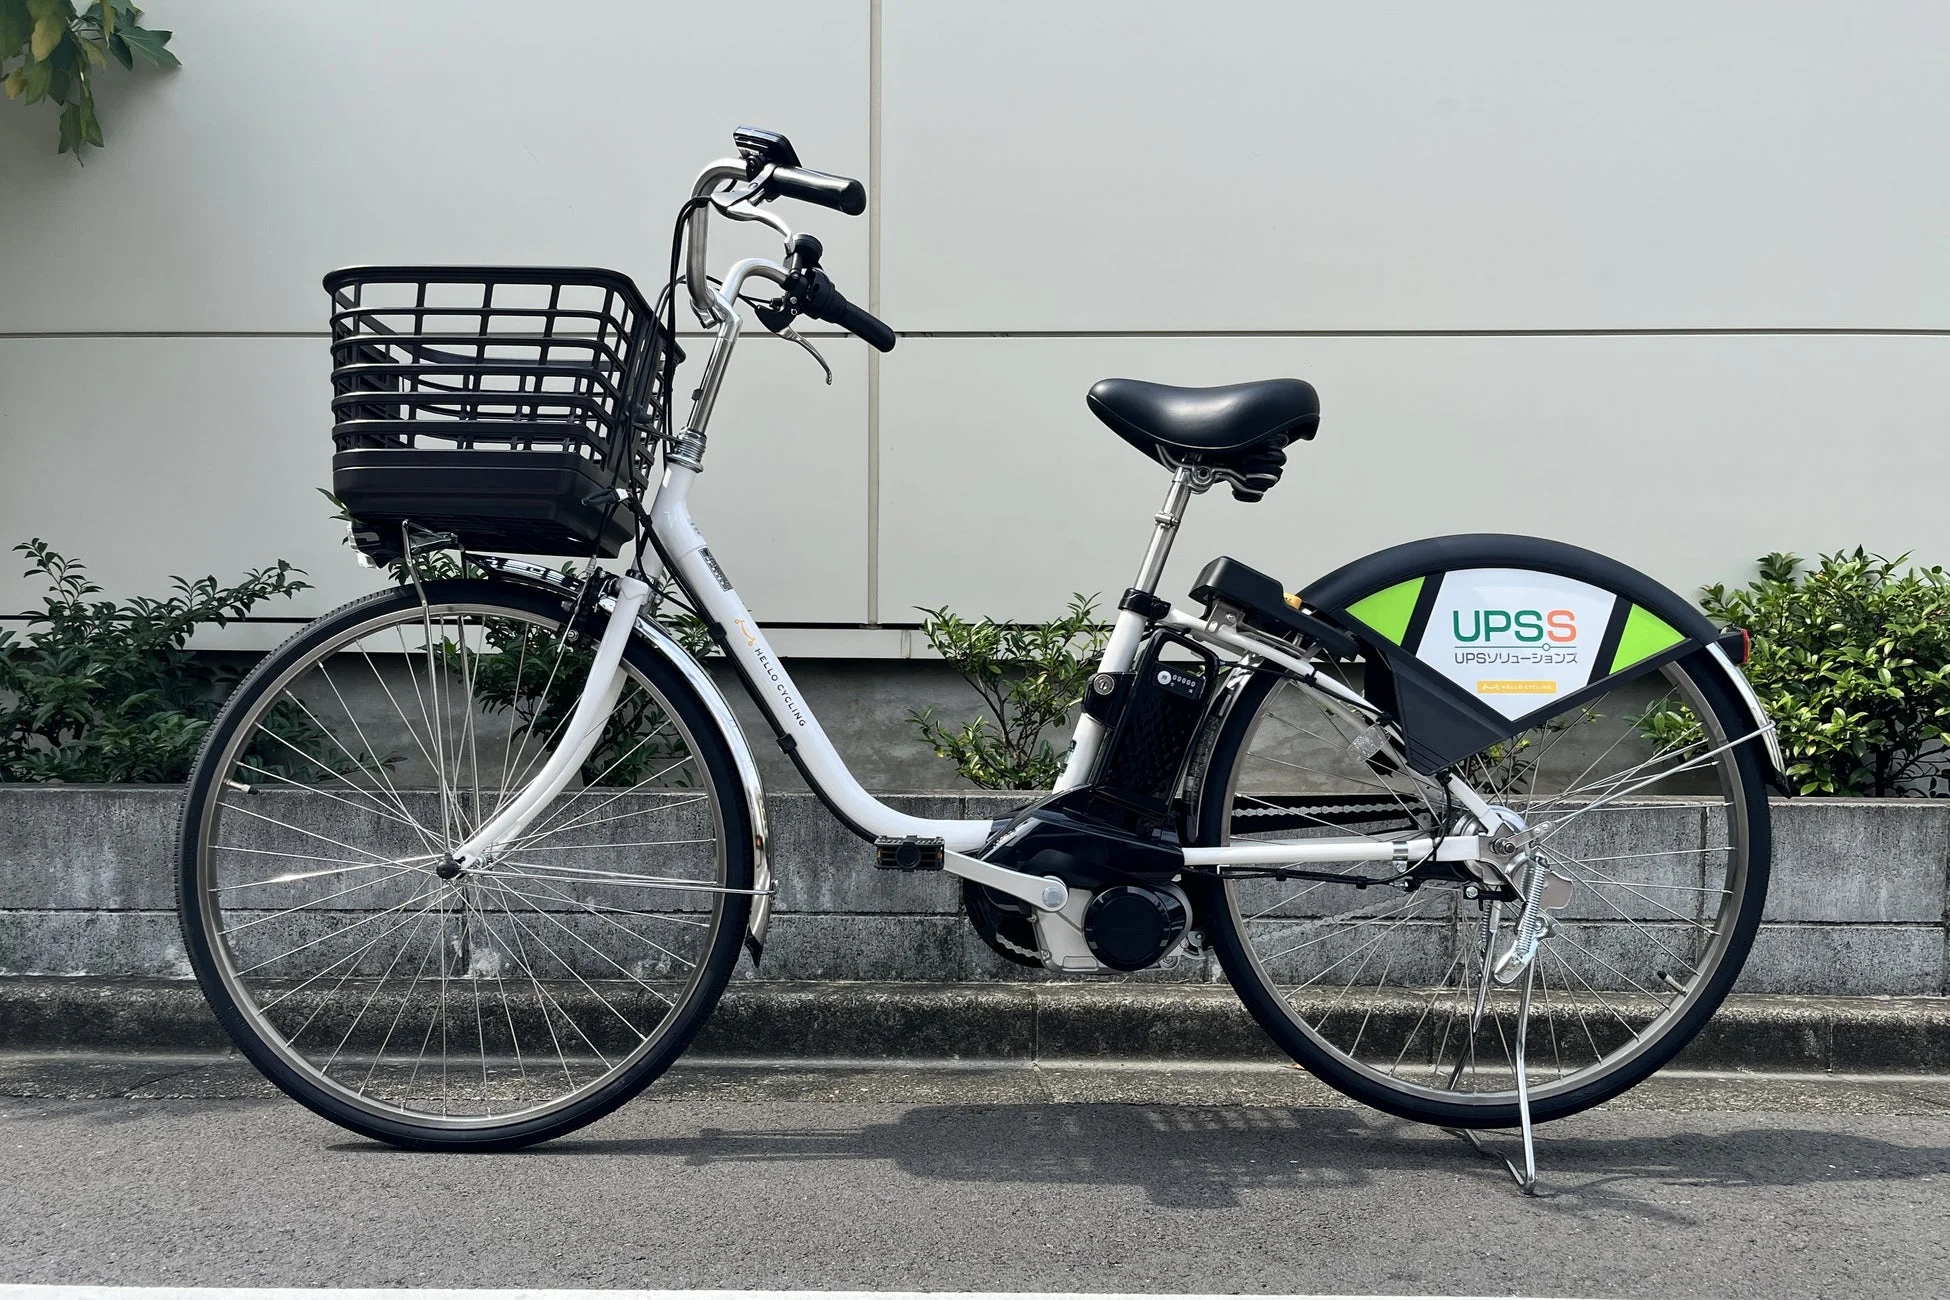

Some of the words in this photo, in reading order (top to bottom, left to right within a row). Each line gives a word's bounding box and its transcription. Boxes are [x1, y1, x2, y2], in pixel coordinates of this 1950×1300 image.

[1453, 610, 1577, 642] UPSS
[1454, 652, 1578, 665] UPSソリューションズ
[754, 648, 779, 682] HELLO
[777, 684, 807, 727] CYCLING
